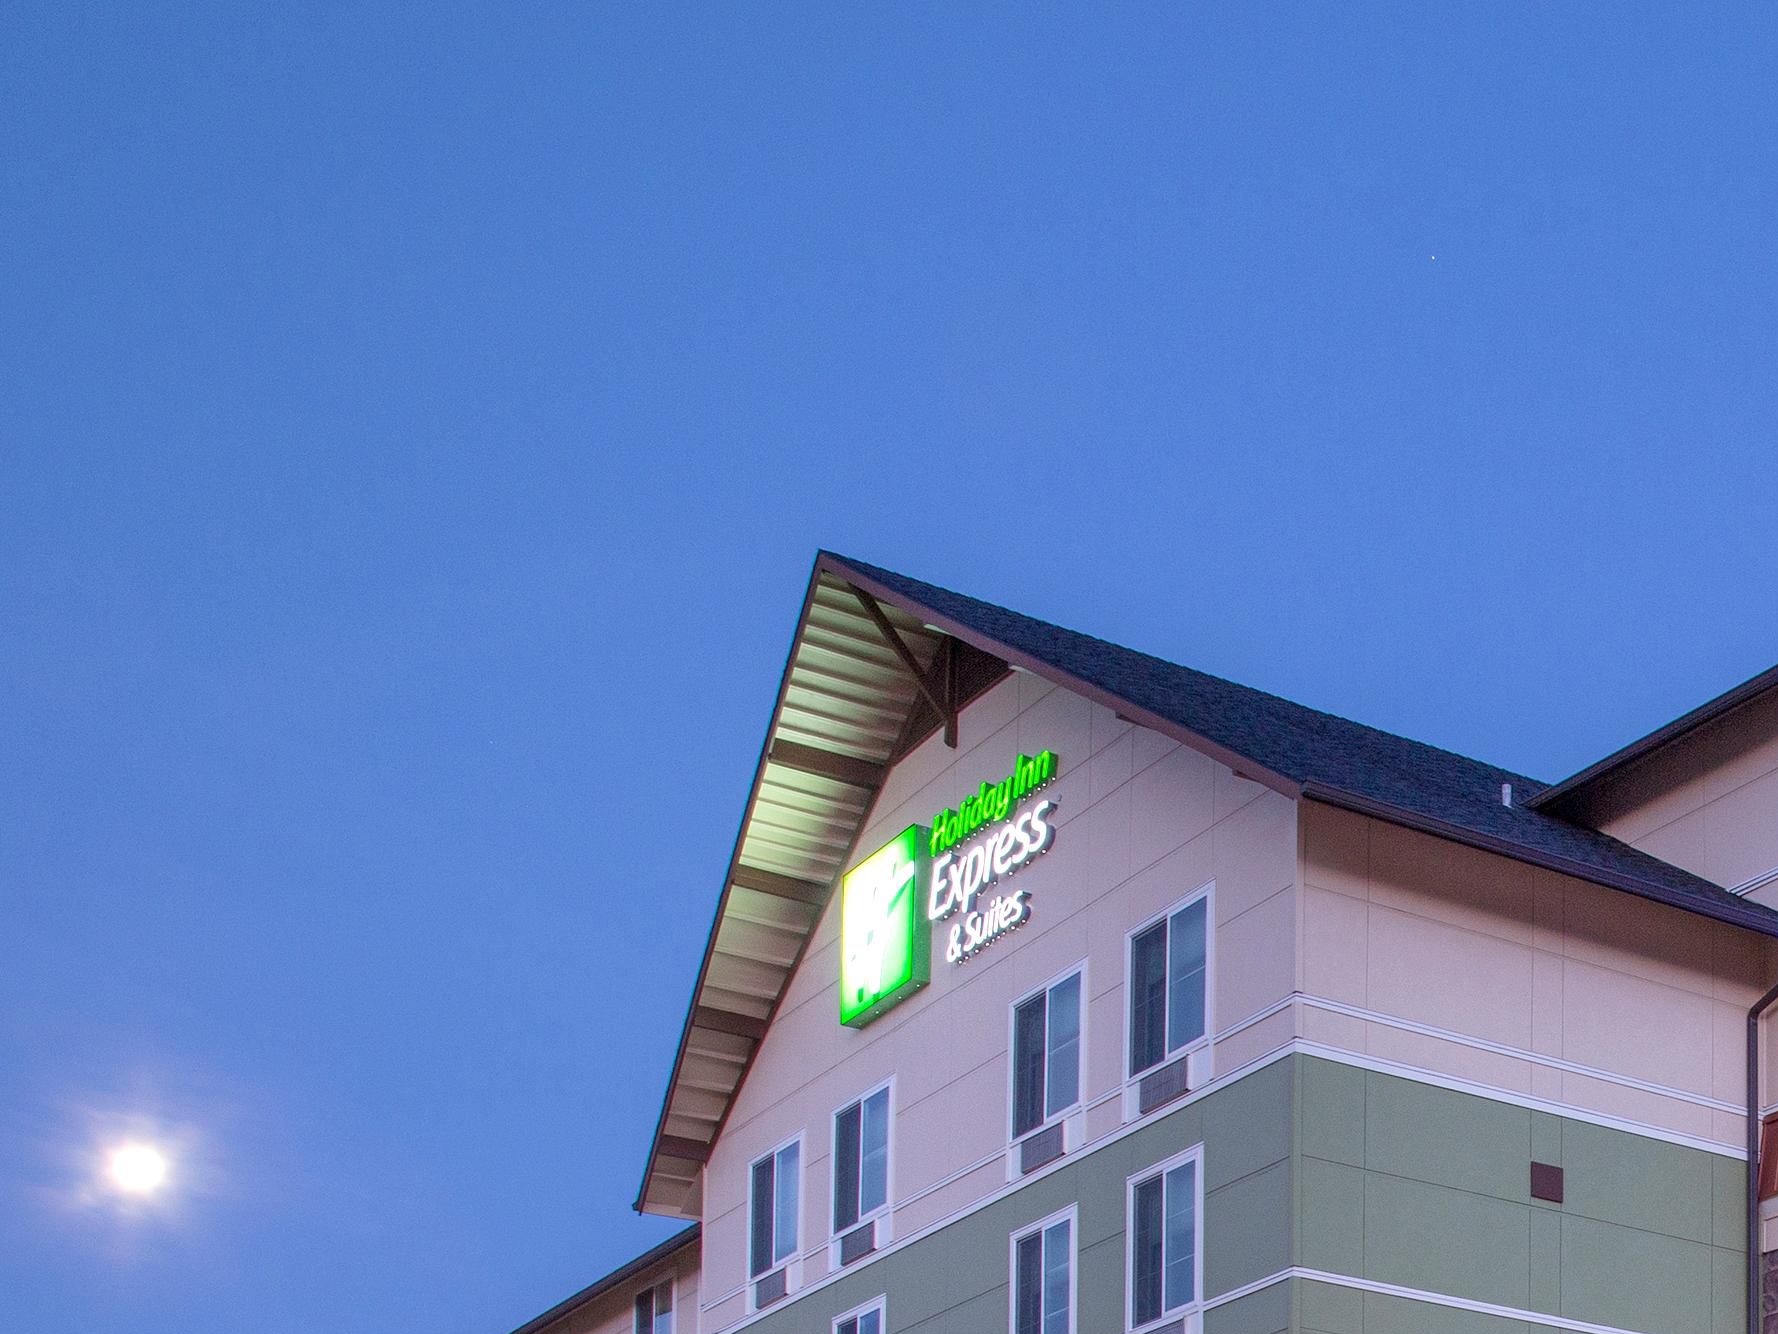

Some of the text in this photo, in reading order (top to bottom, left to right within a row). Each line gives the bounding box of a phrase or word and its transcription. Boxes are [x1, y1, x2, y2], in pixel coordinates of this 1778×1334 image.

[929, 749, 1053, 858] Holiday Inn
[928, 799, 1053, 921] Express
[946, 889, 1024, 963] & Suites
